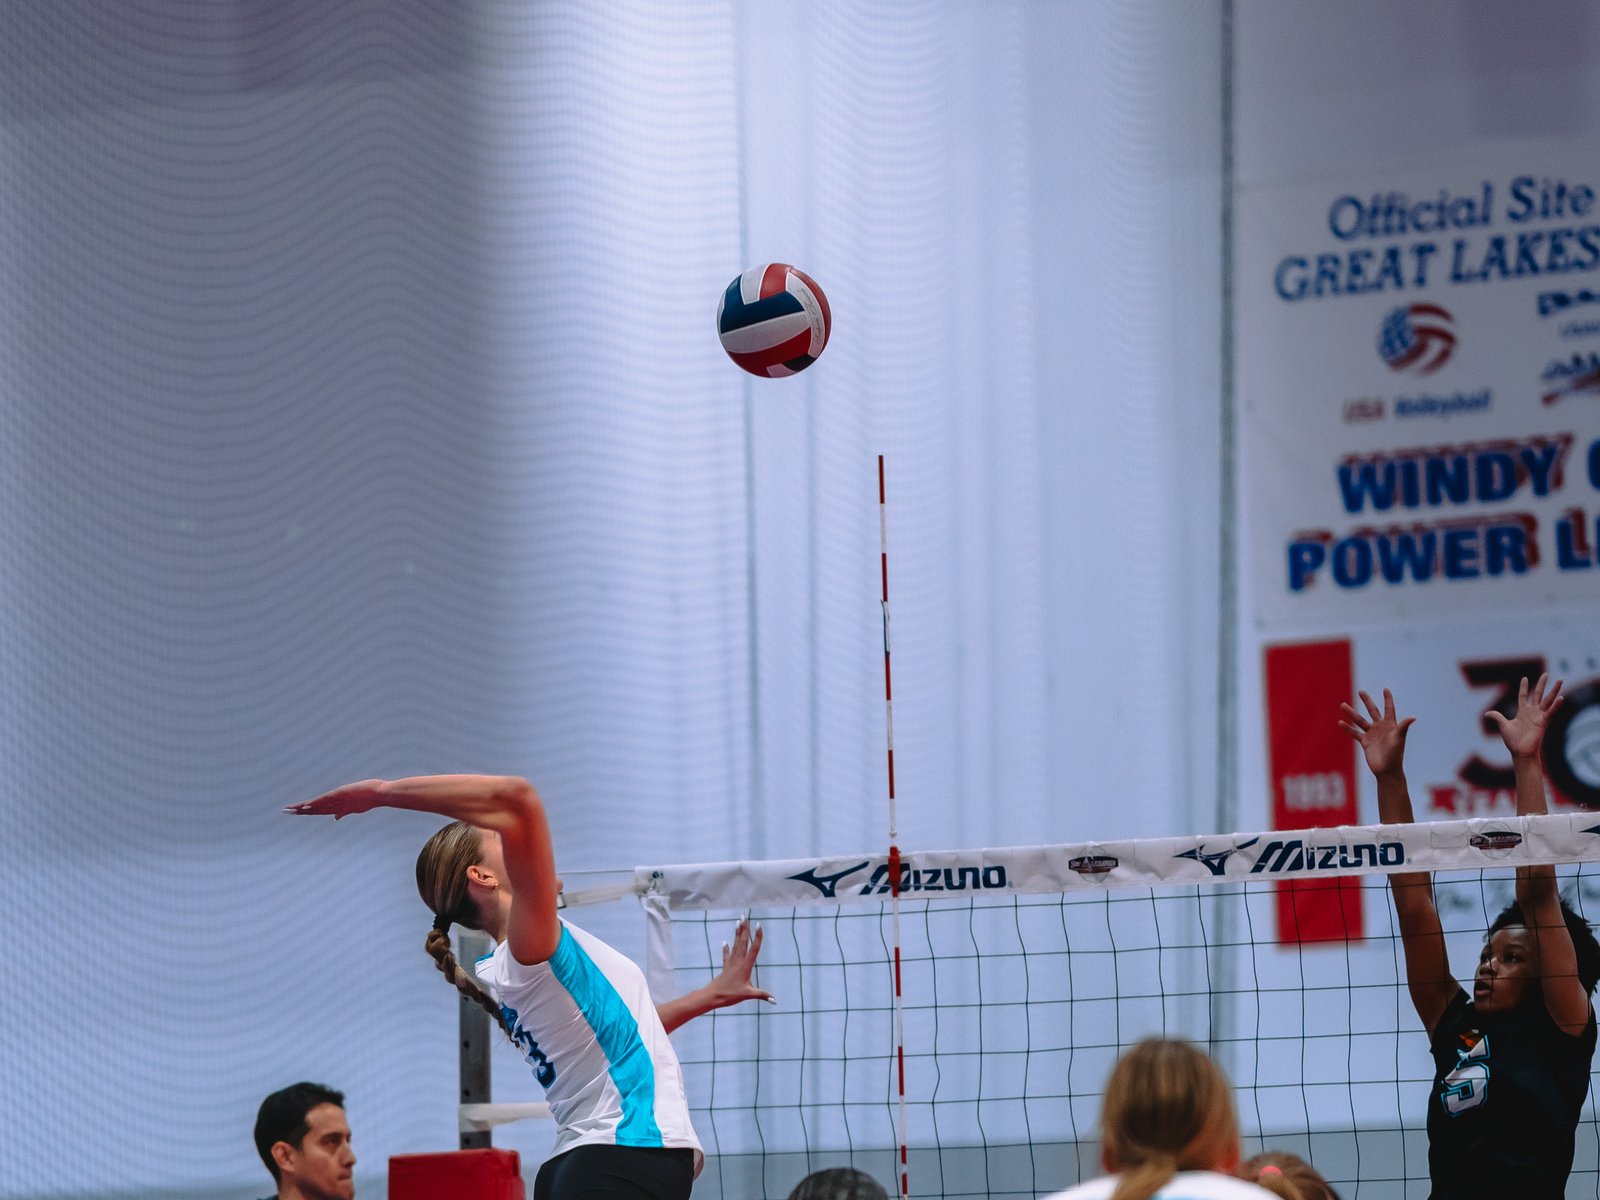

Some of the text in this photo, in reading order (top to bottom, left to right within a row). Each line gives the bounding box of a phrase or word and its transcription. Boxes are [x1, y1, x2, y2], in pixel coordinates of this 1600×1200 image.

[1328, 175, 1596, 242] Official Site
[1274, 225, 1600, 302] GREAT LAKES
[1337, 434, 1572, 513] WINDY
[1288, 512, 1539, 592] POWER
